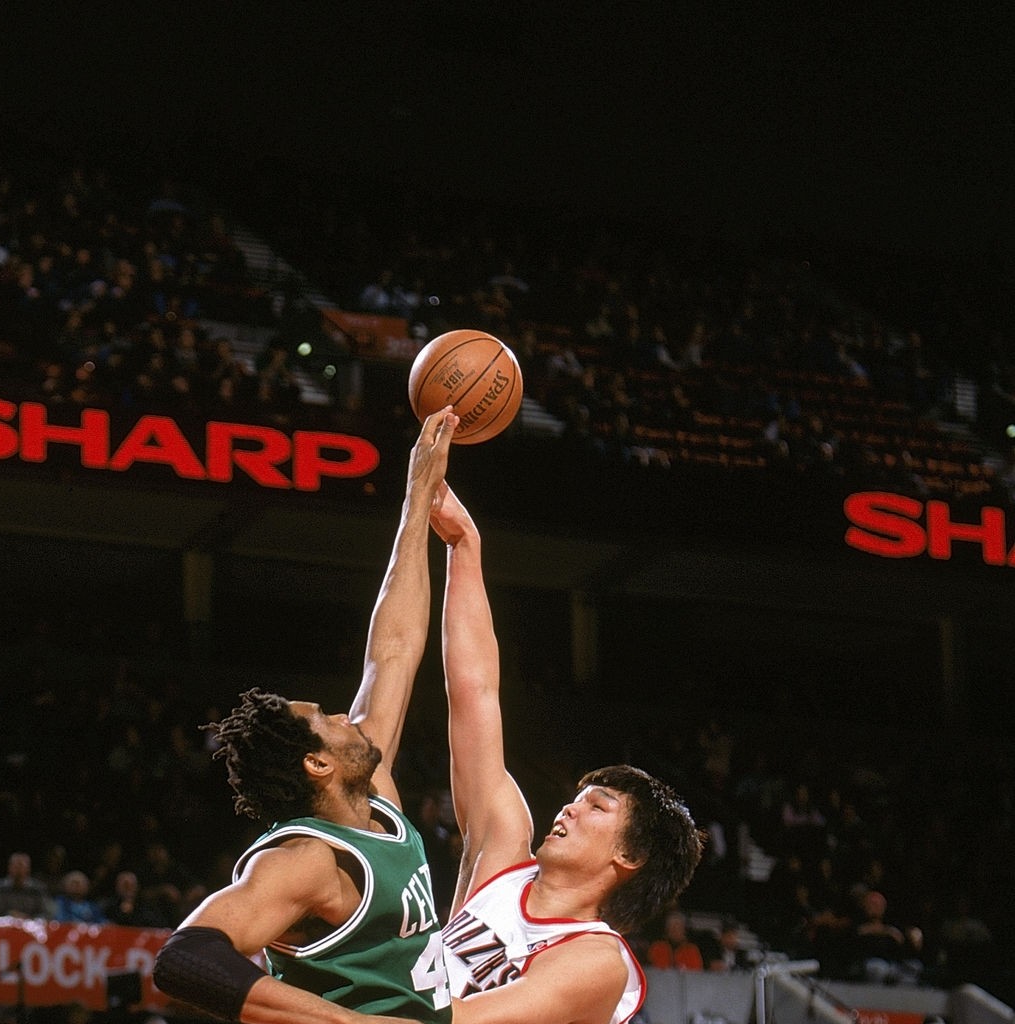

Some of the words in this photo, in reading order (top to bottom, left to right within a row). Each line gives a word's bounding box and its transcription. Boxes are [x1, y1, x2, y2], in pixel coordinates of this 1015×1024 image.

[442, 368, 465, 391] NBA
[455, 369, 510, 434] SPALDING
[843, 490, 1015, 569] SH
